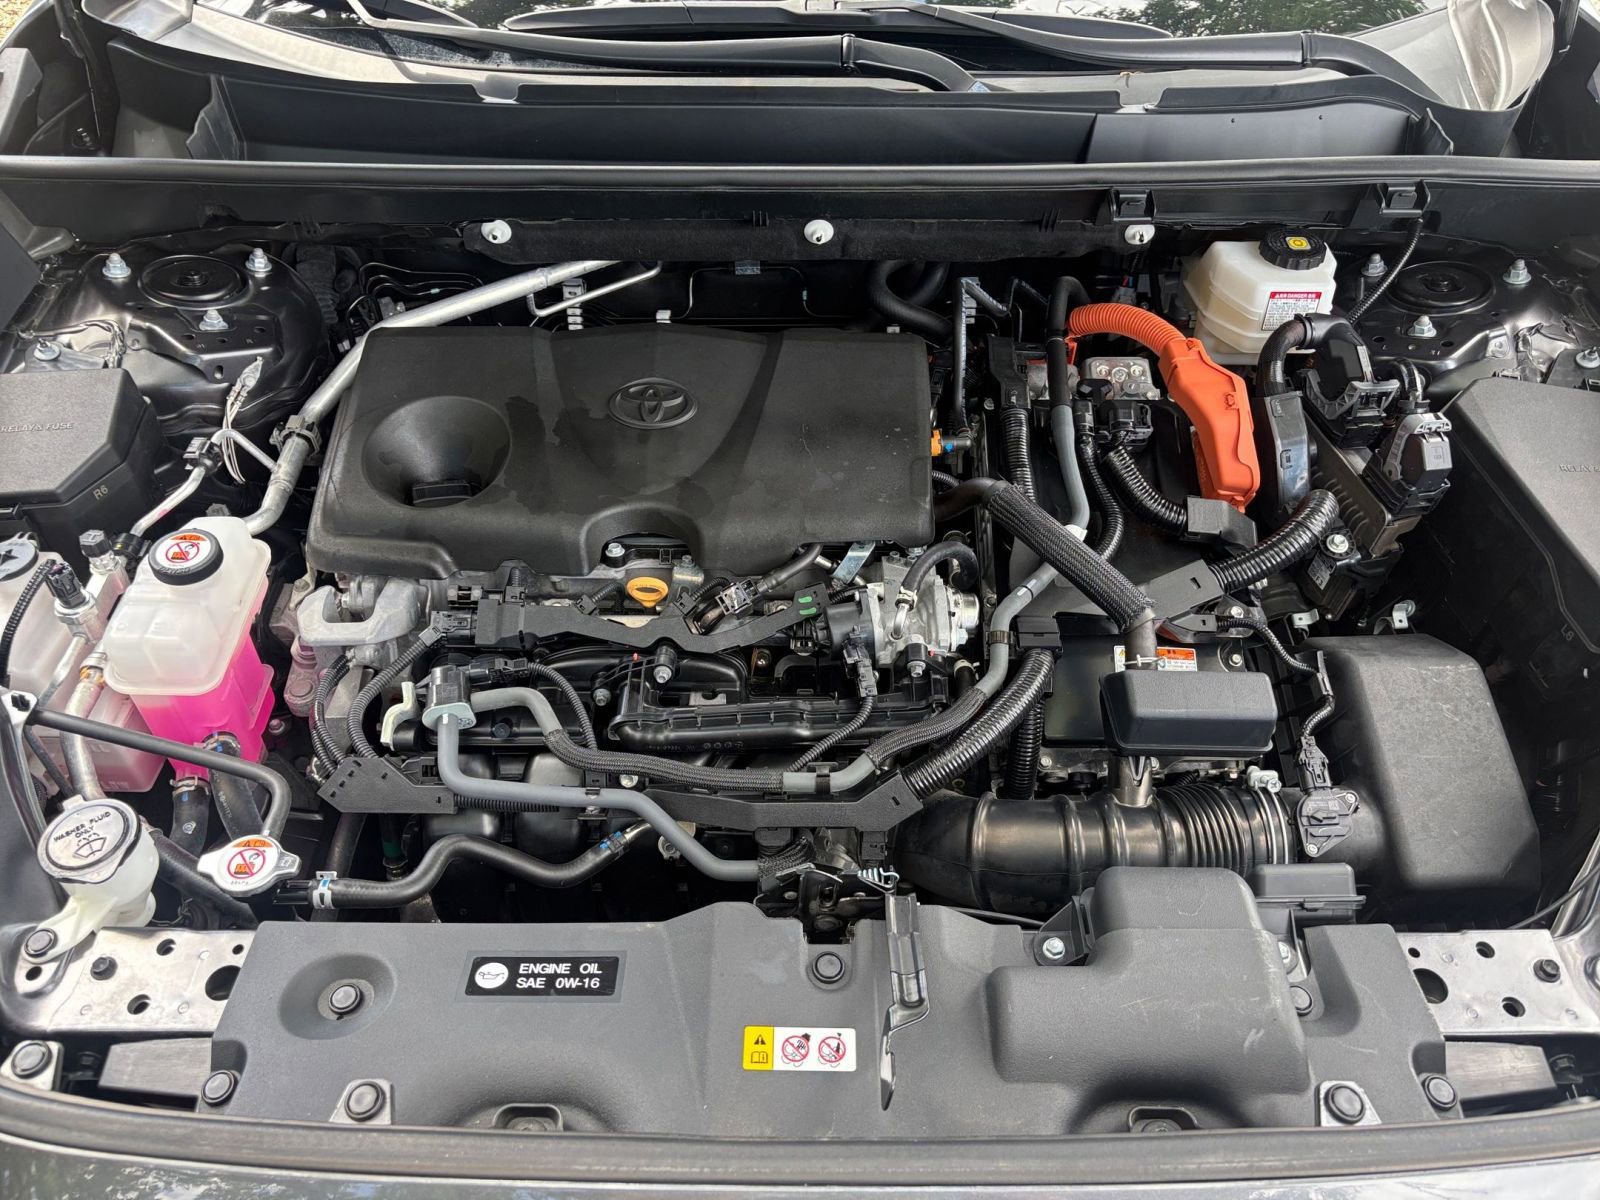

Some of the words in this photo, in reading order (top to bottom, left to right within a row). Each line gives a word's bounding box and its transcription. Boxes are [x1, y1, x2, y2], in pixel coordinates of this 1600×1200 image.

[0, 424, 34, 433] RELAY
[46, 422, 74, 430] FUSE
[93, 484, 109, 501] R6
[53, 823, 86, 843] WASHER
[89, 811, 112, 825] FLUID
[75, 825, 95, 839] ONLY
[518, 963, 571, 974] ENGINE
[579, 963, 603, 974] OIL
[515, 977, 547, 989] SAE
[555, 977, 601, 989] 0W-16
